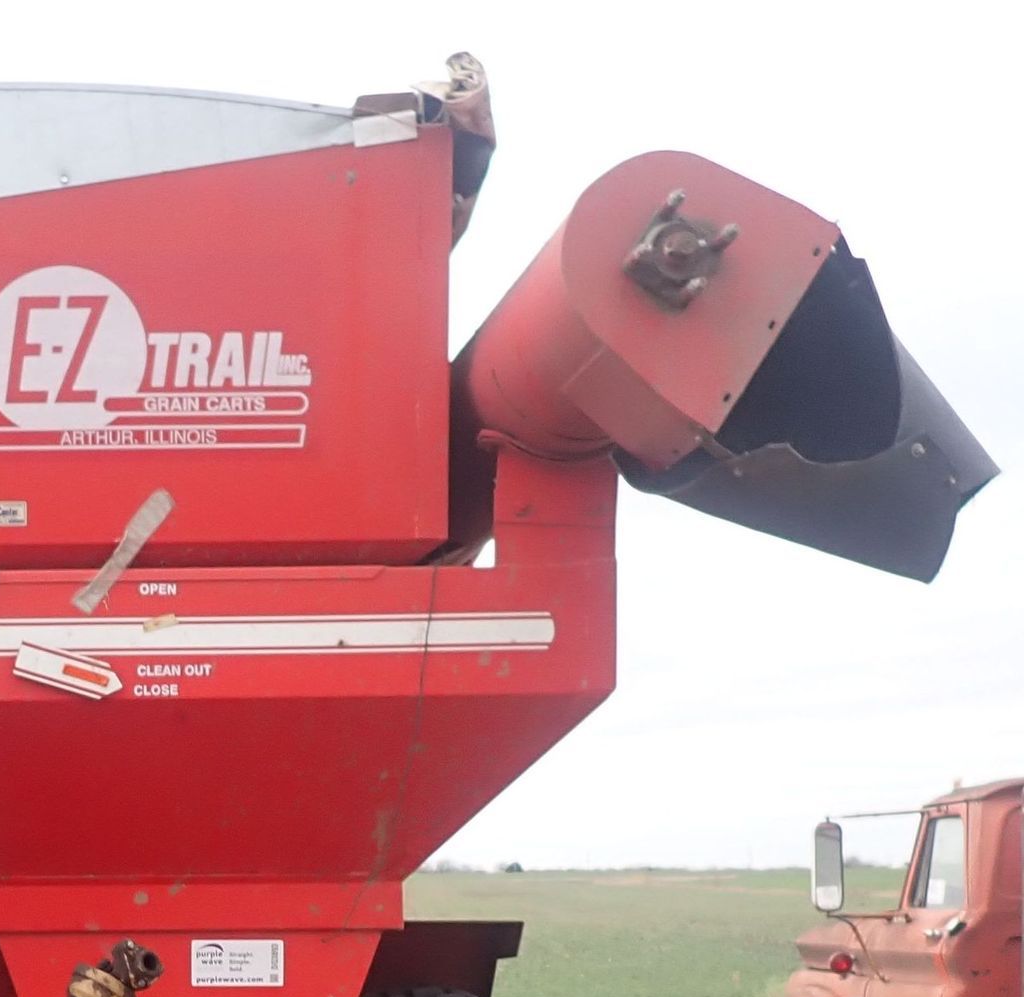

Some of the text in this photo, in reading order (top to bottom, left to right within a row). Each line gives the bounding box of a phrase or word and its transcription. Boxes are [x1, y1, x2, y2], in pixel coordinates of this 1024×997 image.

[147, 331, 312, 387] TRAIL
[278, 354, 310, 377] INC.
[144, 396, 266, 412] GRAIN CARTS
[144, 429, 218, 444] ILLINOIS
[139, 583, 177, 596] OPEN
[137, 664, 212, 676] CLEAN OUT
[133, 684, 179, 697] CLOSE
[196, 950, 223, 959] purple
[196, 976, 264, 984] purplewave.com
